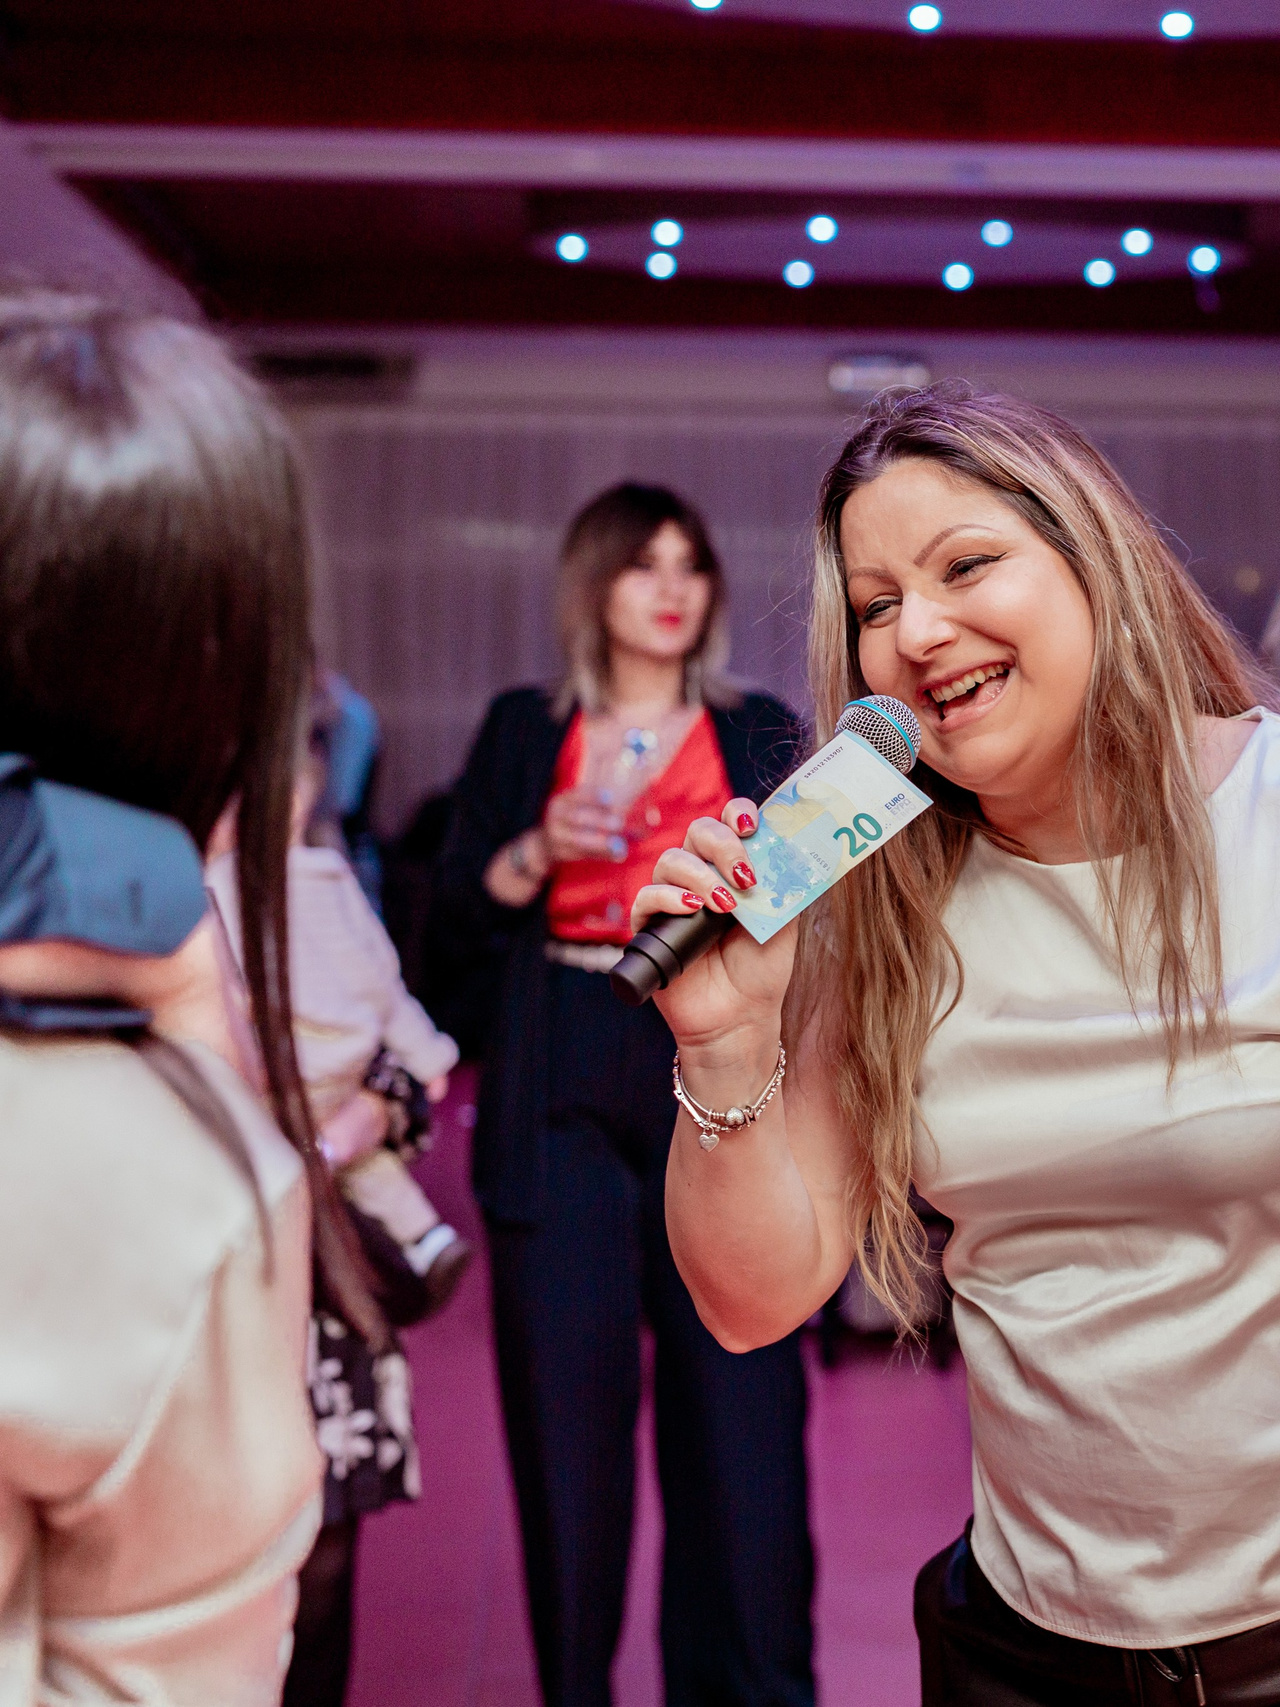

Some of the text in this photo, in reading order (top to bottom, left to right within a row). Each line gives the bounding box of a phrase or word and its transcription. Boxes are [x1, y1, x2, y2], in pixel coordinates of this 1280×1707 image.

[884, 793, 905, 810] EURO
[833, 813, 883, 858] 20
[809, 851, 831, 872] 183907
